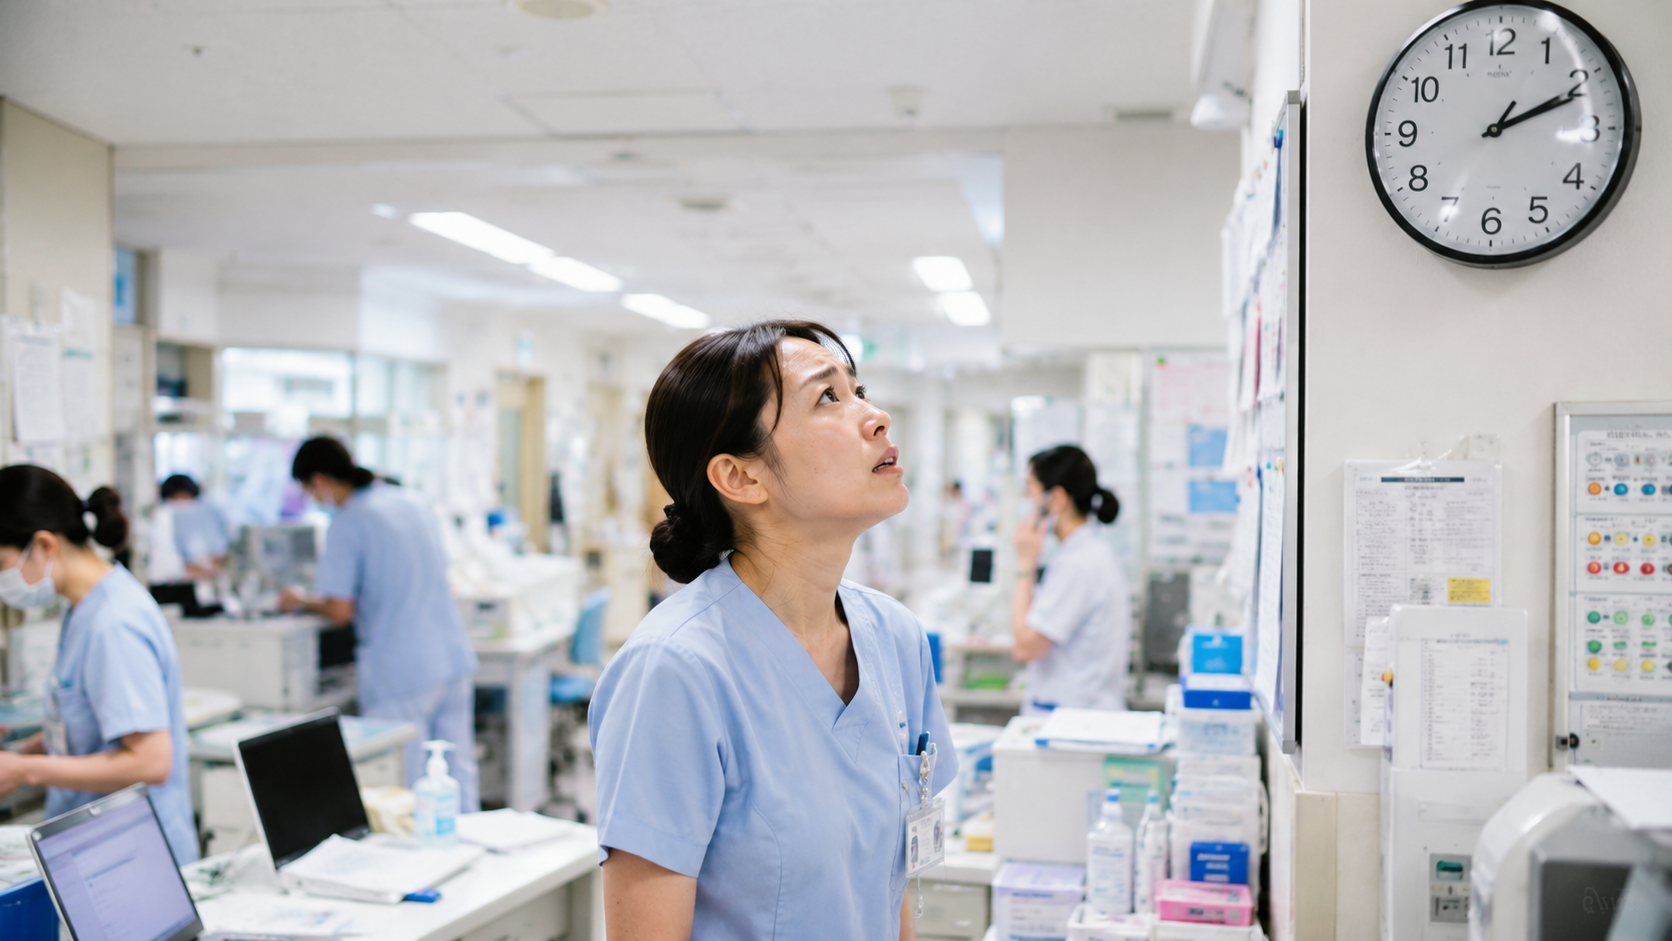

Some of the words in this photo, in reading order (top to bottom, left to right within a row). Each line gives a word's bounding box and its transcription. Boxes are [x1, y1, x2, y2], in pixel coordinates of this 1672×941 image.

[1485, 28, 1516, 56] 12
[1541, 37, 1550, 64] 1
[1445, 43, 1468, 69] 11
[1411, 76, 1440, 103] 10
[1567, 69, 1589, 97] 2
[1398, 120, 1418, 147] 9
[1579, 115, 1600, 142] 3
[1408, 165, 1429, 192] 8
[1562, 163, 1585, 190] 4
[1441, 196, 1459, 222] 7
[1481, 207, 1502, 235] 6
[1528, 196, 1549, 224] 5
